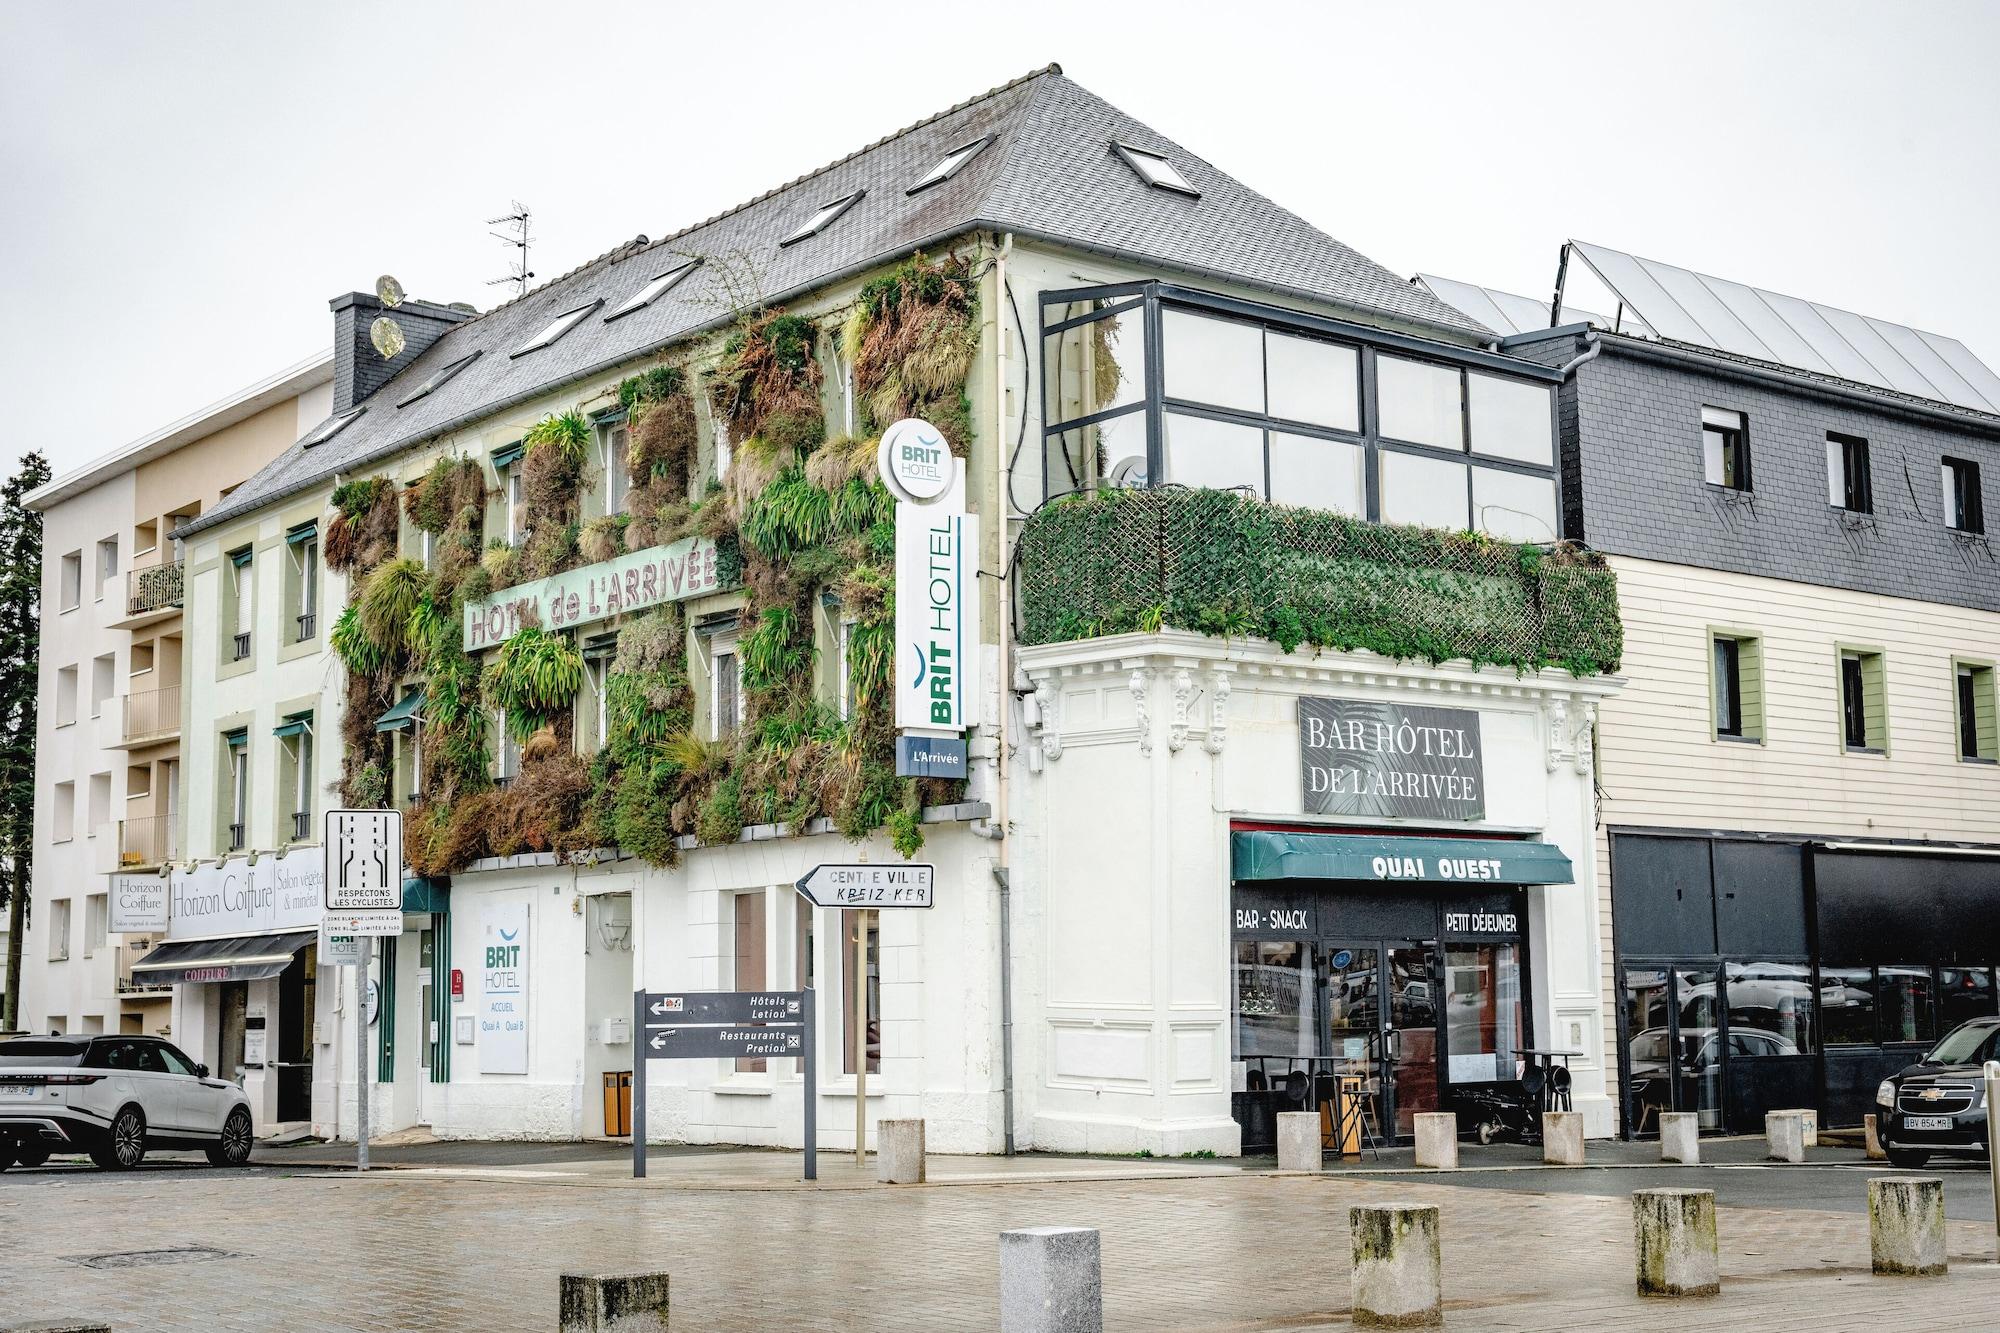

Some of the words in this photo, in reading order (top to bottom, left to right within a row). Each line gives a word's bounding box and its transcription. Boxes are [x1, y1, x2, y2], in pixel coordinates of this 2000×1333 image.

[902, 445, 941, 464] BRIT
[902, 463, 941, 478] HOTEL
[929, 515, 951, 631] HOTEL
[551, 585, 580, 626] de
[588, 538, 717, 615] L'ARRIVÉE
[930, 641, 951, 724] BRIT
[1308, 717, 1370, 751] BAR
[1375, 717, 1474, 759] HÔTEL
[914, 751, 958, 764] L'Arrivée
[1310, 766, 1345, 794] DE
[1352, 768, 1477, 801] L'ARRIVÉE
[1372, 857, 1425, 879] QUAI
[1438, 858, 1502, 880] OUEST
[277, 868, 298, 889] Salon
[300, 870, 324, 891] végéta
[830, 871, 880, 884] CENTE
[120, 879, 162, 893] Horizon
[338, 889, 391, 897] RESPECTONS
[173, 882, 220, 918] Horizon
[223, 872, 272, 918] Coiffure
[334, 898, 350, 906] LES
[352, 898, 394, 906] CYCLISTES
[120, 895, 162, 911] Coiffure
[1236, 909, 1259, 929] BAR
[1270, 909, 1308, 929] SNACK
[1446, 913, 1469, 932] PETIT
[1471, 907, 1517, 932] DÉJEUNER
[330, 944, 357, 953] HOTE
[486, 946, 520, 968] BRIT
[185, 967, 229, 981] COIFFURE
[485, 972, 520, 989] HOTEL
[491, 1002, 514, 1012] ACCUEIL
[750, 996, 785, 1006] Hôtels
[752, 1009, 786, 1019] Letioù
[495, 1020, 501, 1031] A
[519, 1020, 524, 1031] B
[720, 1031, 786, 1041] Restaurants
[746, 1043, 786, 1053] Pretioù
